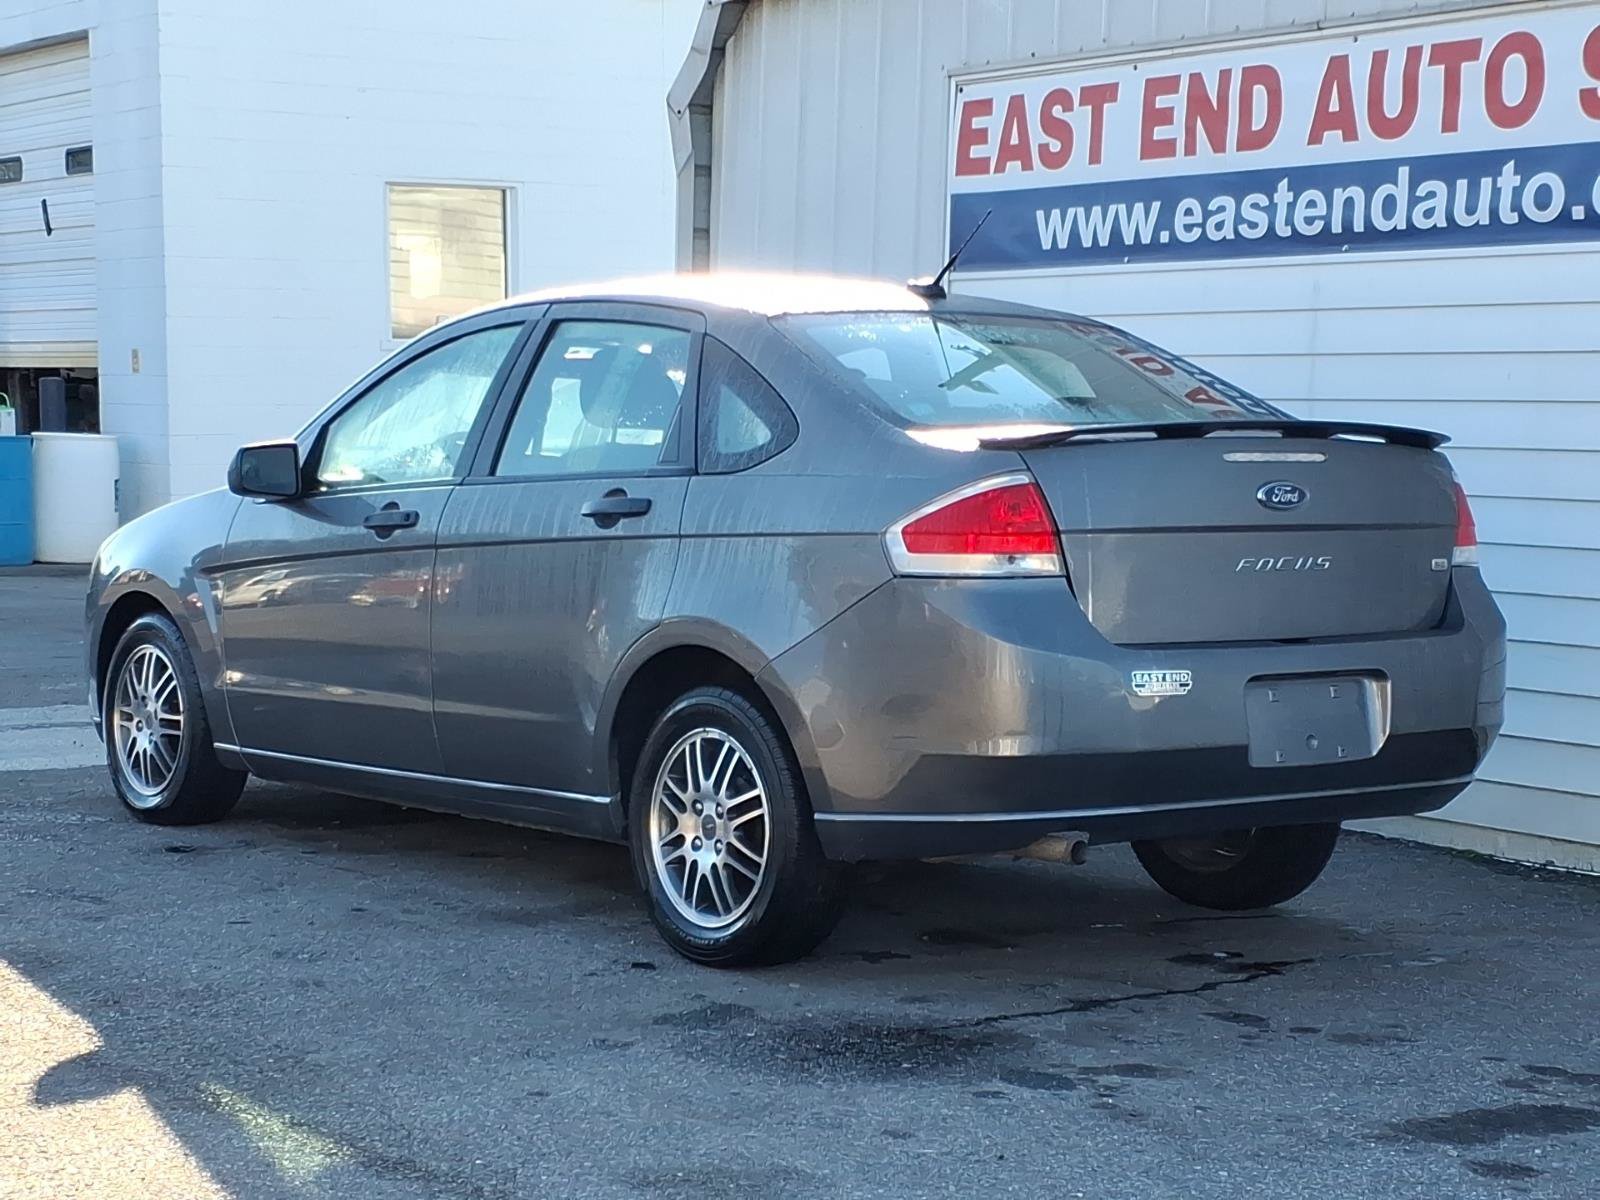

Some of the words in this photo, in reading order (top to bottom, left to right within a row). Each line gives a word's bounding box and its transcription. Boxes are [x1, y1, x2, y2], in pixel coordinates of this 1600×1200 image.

[955, 83, 1119, 177] EAST
[1139, 64, 1282, 161] END
[1307, 31, 1545, 146] AUTO
[1036, 160, 1600, 250] www.eastendauto.
[1272, 486, 1299, 502] Ford
[1236, 556, 1333, 571] FOCUS
[1135, 673, 1164, 683] EAST
[1165, 673, 1189, 682] END
